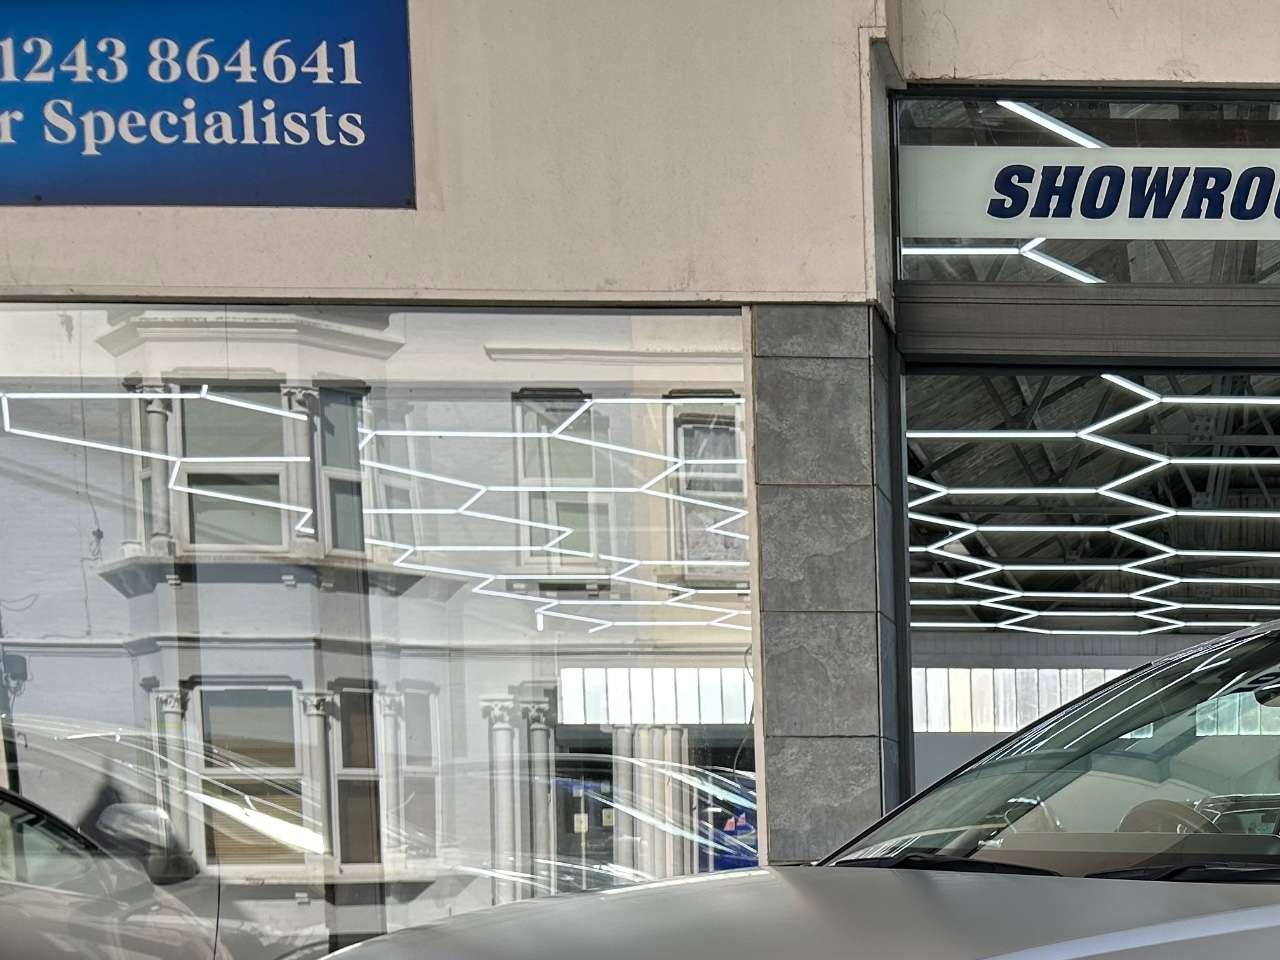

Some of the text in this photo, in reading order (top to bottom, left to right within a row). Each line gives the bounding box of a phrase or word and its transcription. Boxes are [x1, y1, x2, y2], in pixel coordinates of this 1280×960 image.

[0, 37, 362, 84] 1243 864641
[43, 97, 366, 156] Specialists
